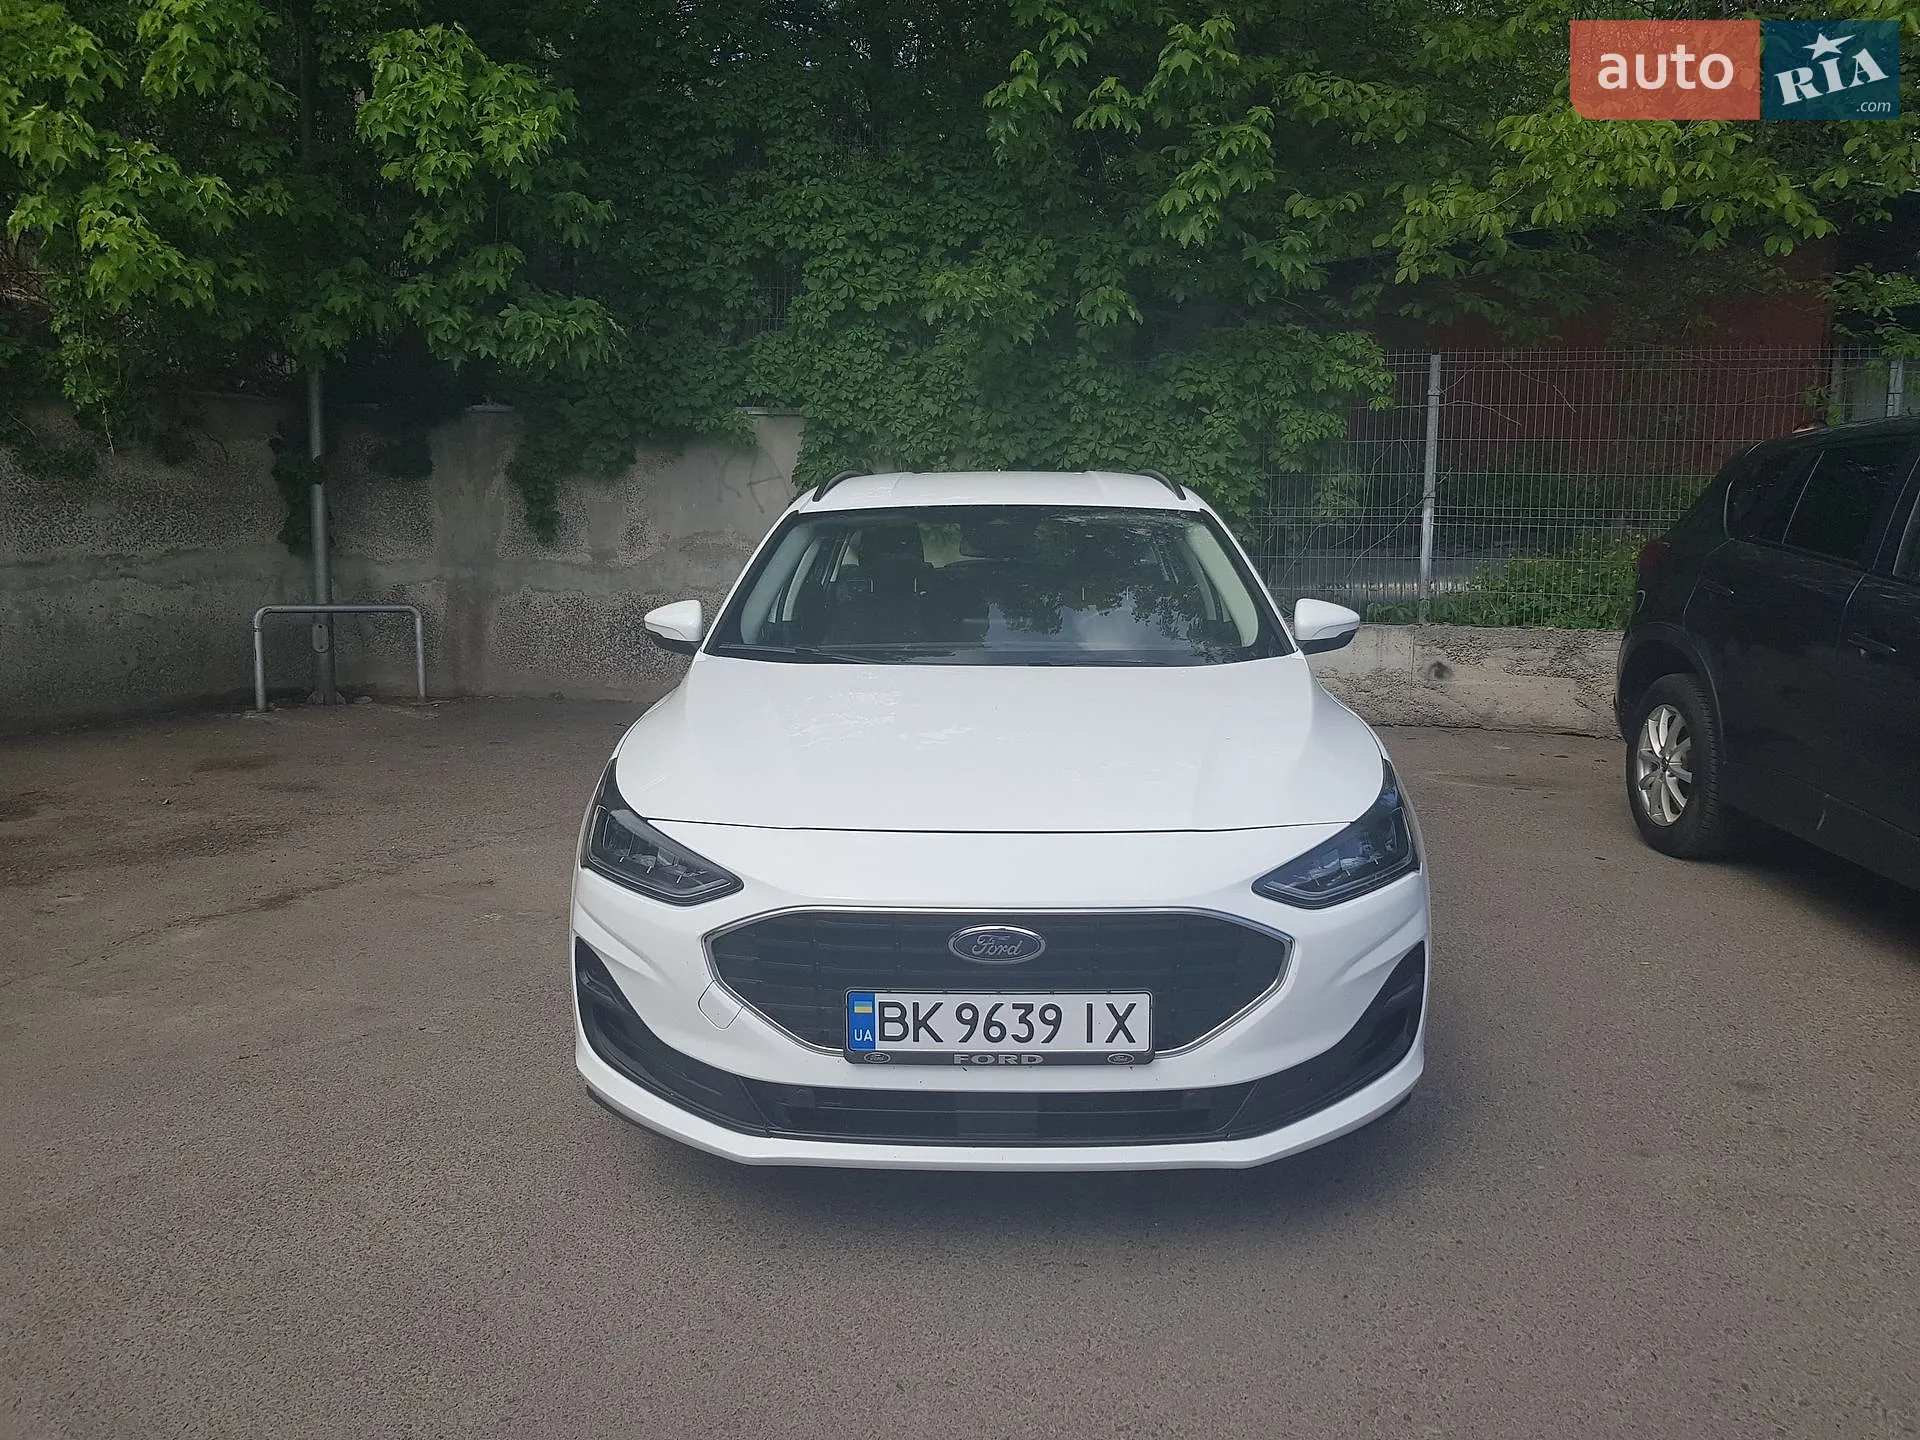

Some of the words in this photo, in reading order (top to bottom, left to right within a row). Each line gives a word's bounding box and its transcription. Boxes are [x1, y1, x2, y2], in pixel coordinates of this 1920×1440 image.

[971, 934, 1024, 956] Ford
[878, 1001, 944, 1043] BK
[955, 1003, 1063, 1044] 9639
[1086, 1002, 1137, 1044] IX
[854, 1029, 873, 1042] UA
[953, 1053, 1044, 1065] FORD
